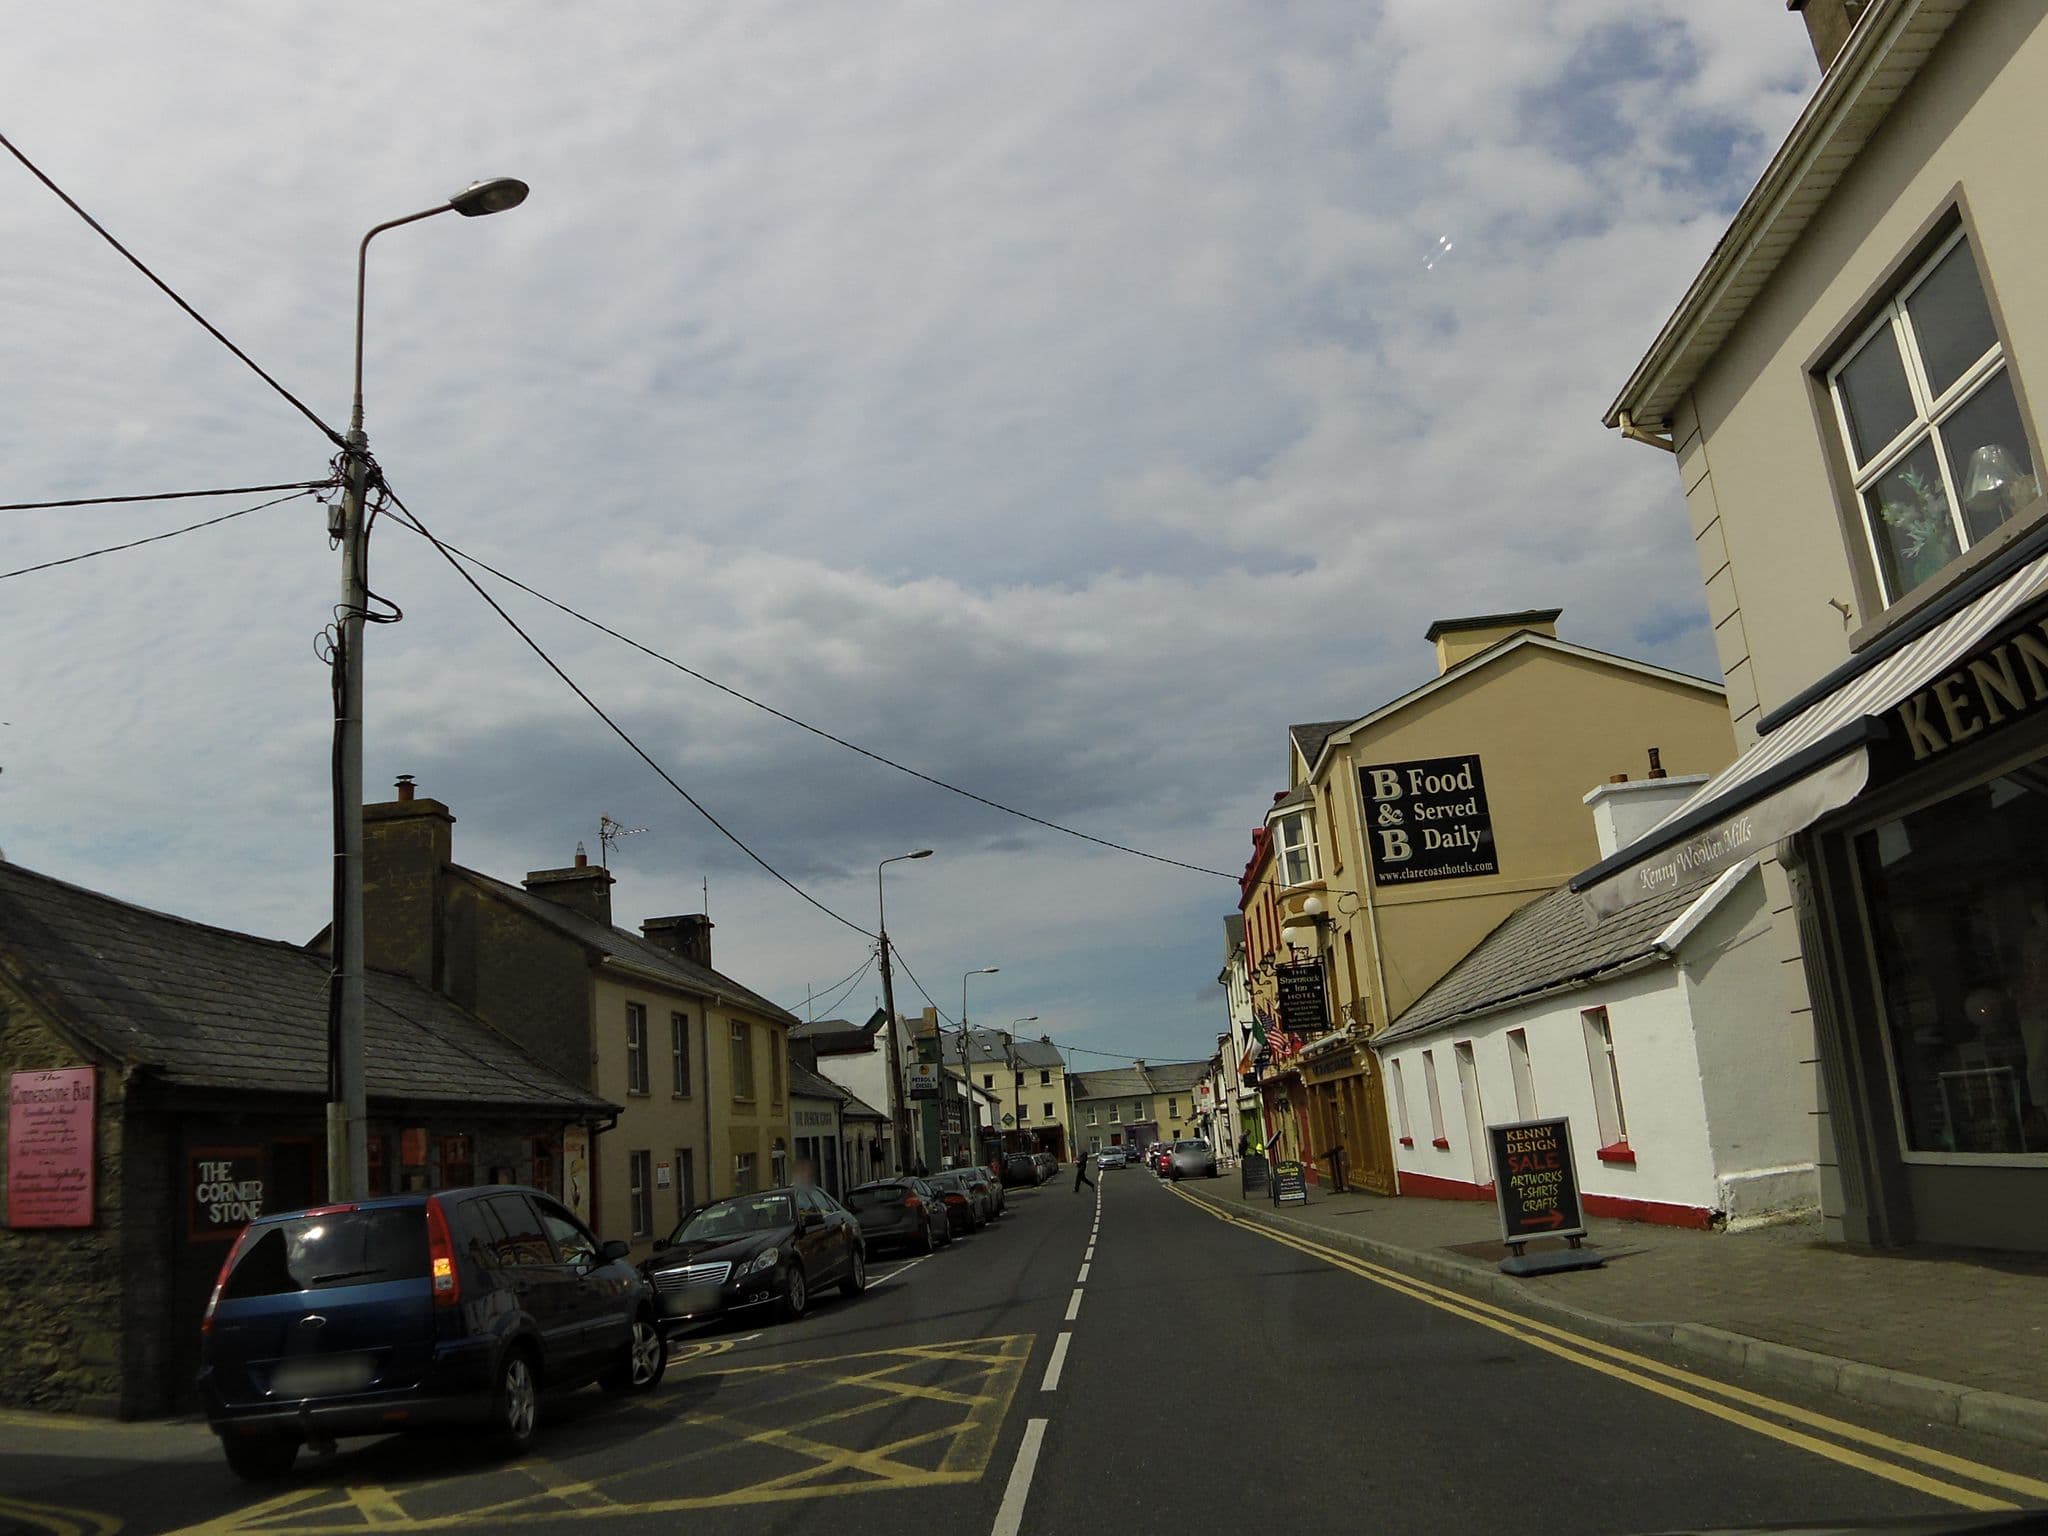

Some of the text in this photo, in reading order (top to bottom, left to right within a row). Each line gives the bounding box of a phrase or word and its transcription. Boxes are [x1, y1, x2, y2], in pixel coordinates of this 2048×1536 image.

[1369, 763, 1475, 802] B Food
[1377, 797, 1479, 828] & Served
[1378, 825, 1482, 863] B Daily
[1639, 816, 1753, 890] Kenny Woollen Mills
[1378, 860, 1494, 882] www.clarecoasthotels.com
[1505, 1126, 1553, 1142] KENNY
[1506, 1138, 1558, 1154] DESIGN
[197, 1161, 233, 1183] THE
[1507, 1153, 1560, 1174] SALE
[1510, 1170, 1563, 1188] ARTWORKS
[196, 1180, 264, 1204] CORNER
[1517, 1183, 1559, 1200] T-SHIRTS
[208, 1200, 263, 1224] STONE
[1522, 1196, 1558, 1213] CRAFTS
